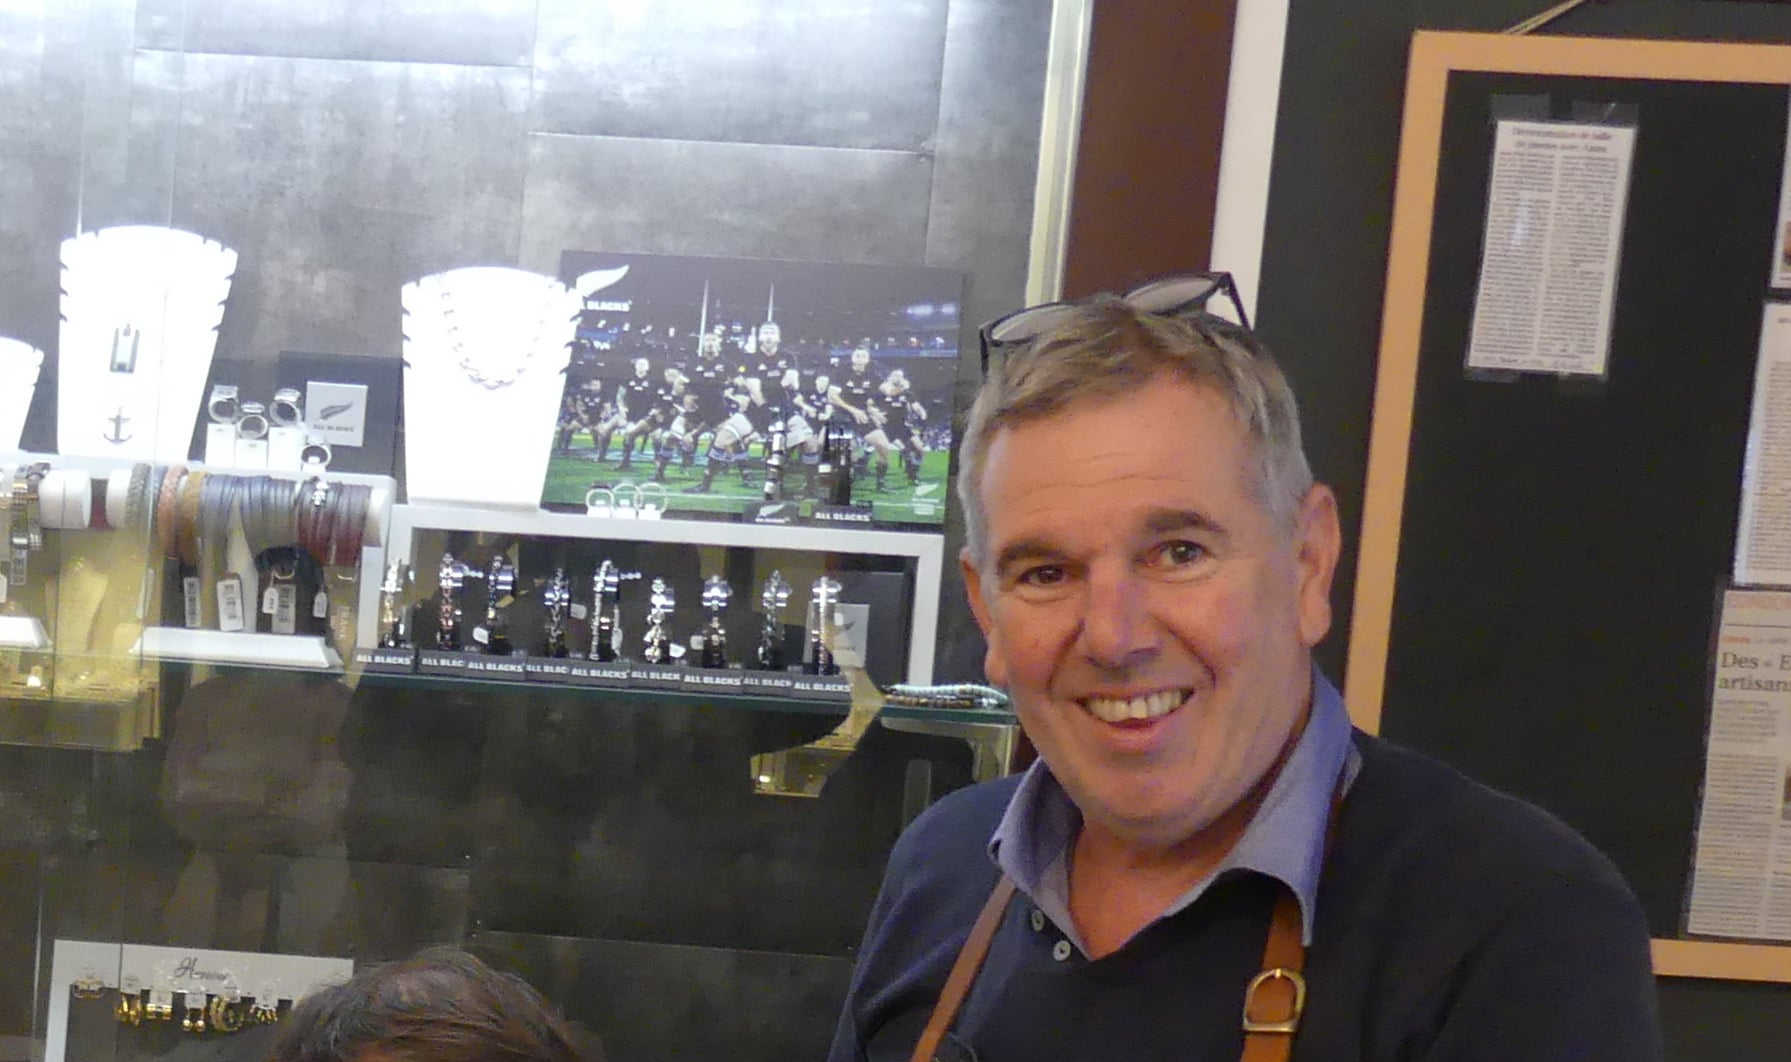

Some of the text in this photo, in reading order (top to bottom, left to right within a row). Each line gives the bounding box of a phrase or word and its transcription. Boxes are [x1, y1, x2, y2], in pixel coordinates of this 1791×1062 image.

[833, 513, 870, 522] BLACKS
[356, 654, 411, 665] ALL BLACKS
[421, 657, 465, 667] ALL BLAC
[1721, 651, 1759, 670] Des
[467, 661, 523, 673] ALL BLACKS
[526, 663, 569, 674] ALL BLAC
[571, 668, 628, 679] ALL BLACKS
[631, 671, 680, 681] ALL BLACK
[684, 674, 741, 686] ALL BLACKS
[743, 677, 759, 686] ALL
[794, 682, 851, 693] ALL BLACKS
